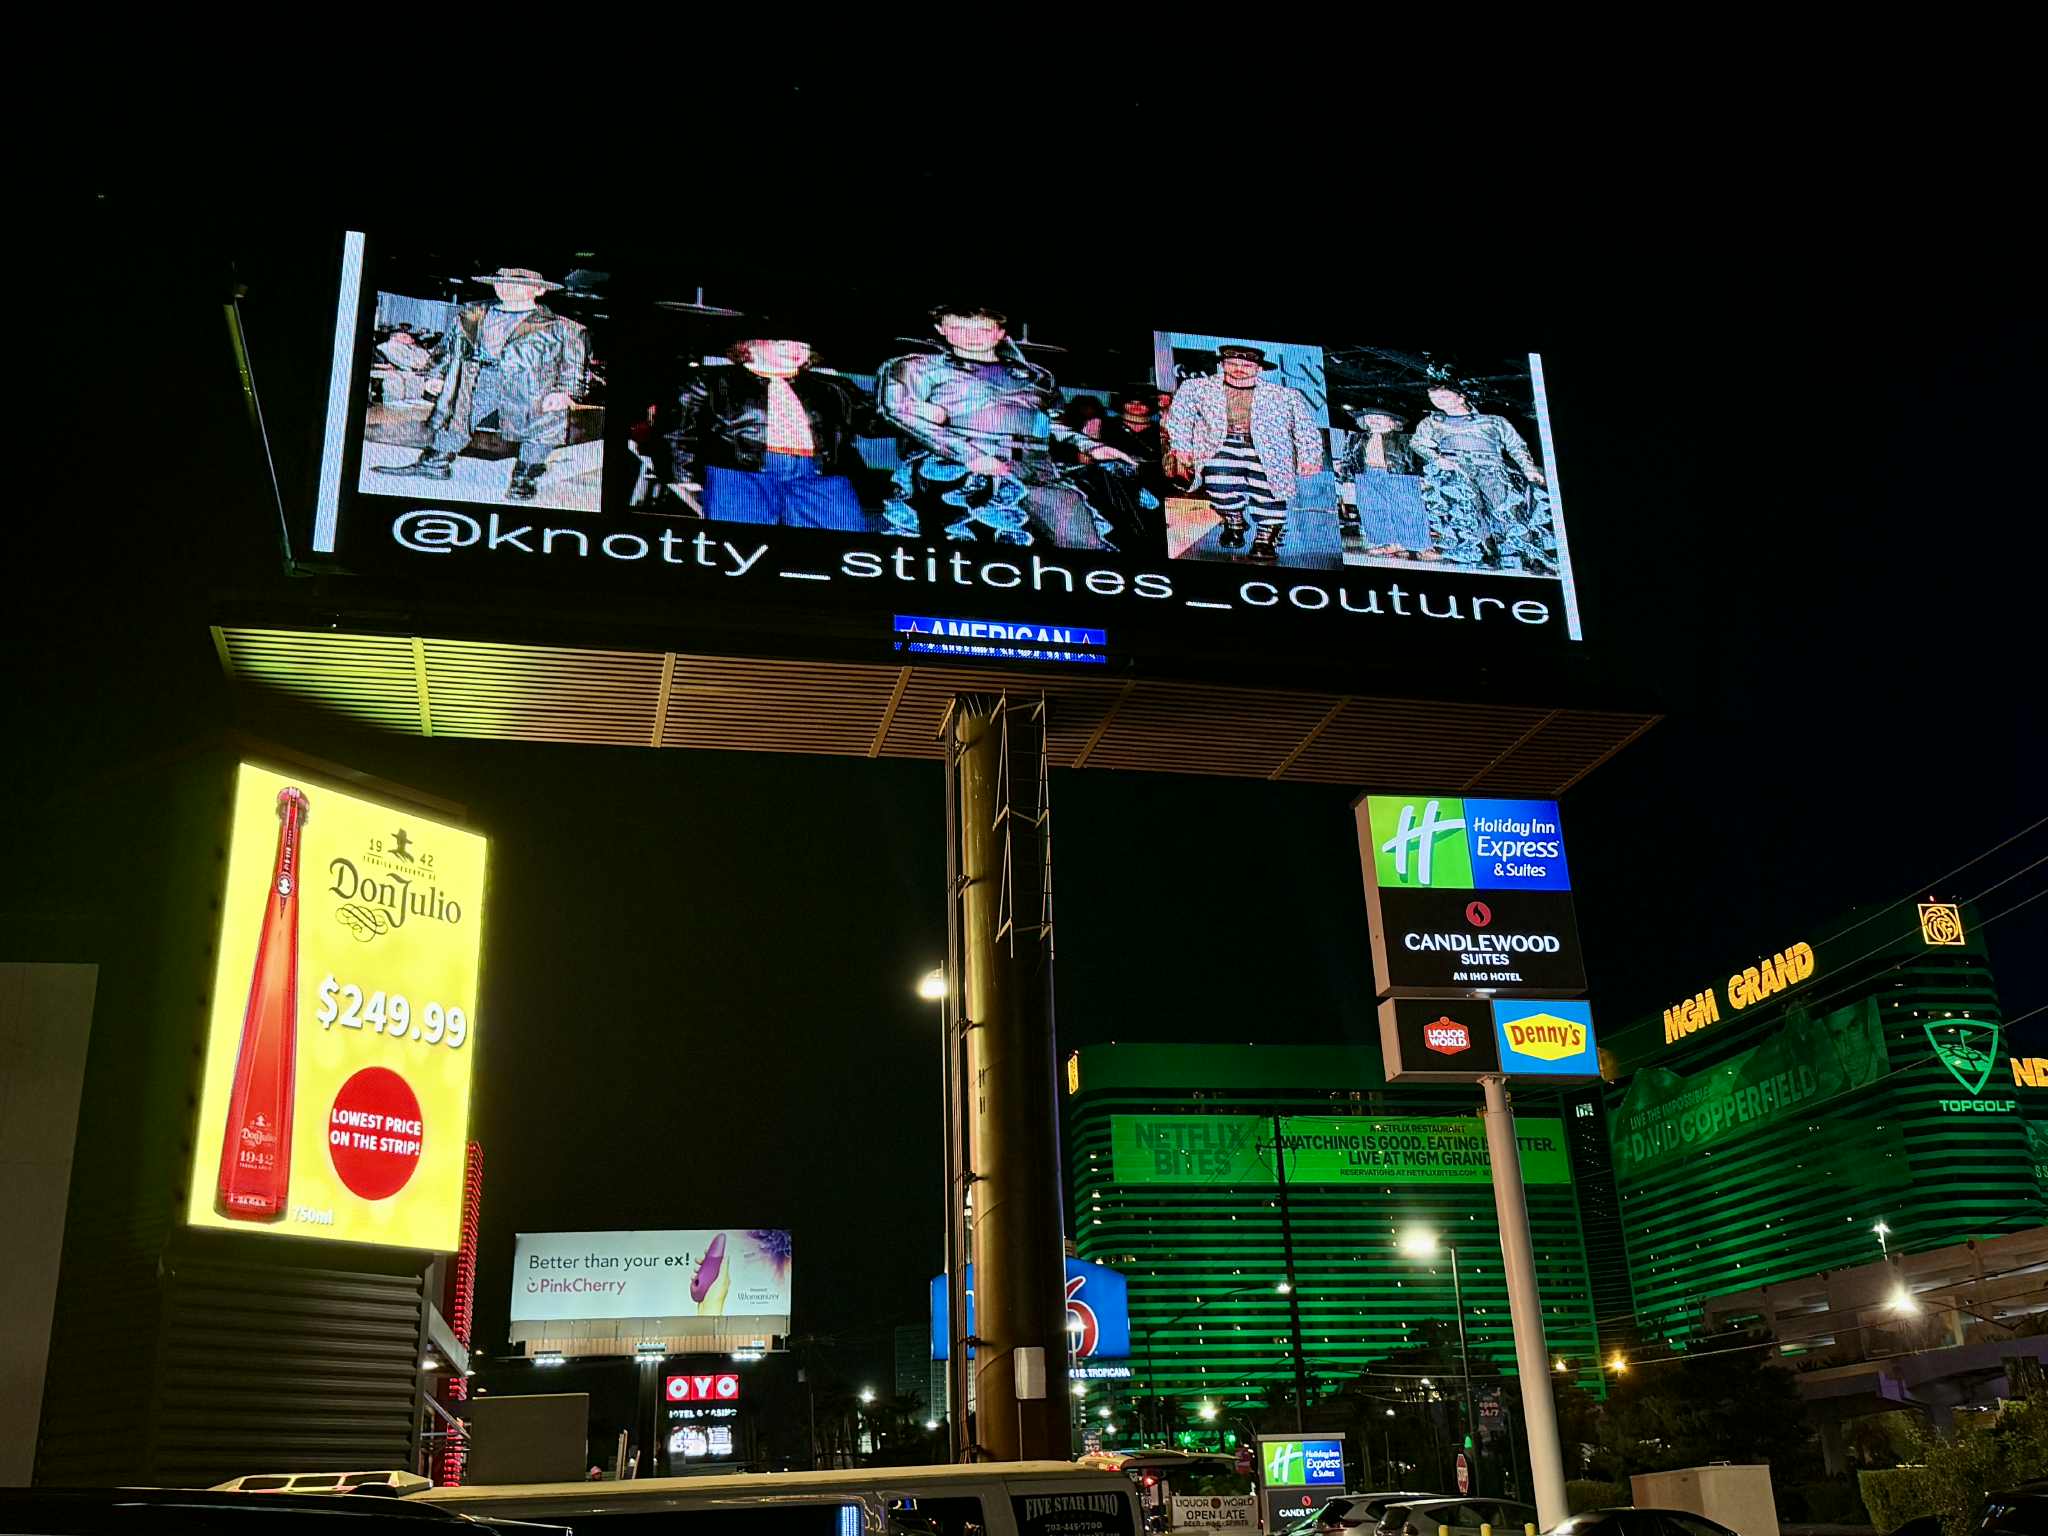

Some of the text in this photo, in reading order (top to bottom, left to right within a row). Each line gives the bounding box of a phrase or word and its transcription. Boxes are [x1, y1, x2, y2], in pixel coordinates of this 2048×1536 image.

[392, 509, 1550, 625] @knotty_stitches_couture
[1473, 817, 1555, 836] Holiday Inn
[1477, 836, 1559, 861] Express
[1494, 864, 1546, 877] & Suites
[1404, 933, 1560, 952] CANDLEWOOD
[1461, 954, 1510, 965] SUITES
[1453, 972, 1522, 982] AN IHG HOTEL
[1664, 942, 1814, 1045] MGM GRAND
[317, 973, 467, 1048] $249.99
[1427, 1029, 1466, 1039] LIQUOR
[1429, 1037, 1467, 1047] WORLD
[1510, 1023, 1580, 1047] Denny's
[1939, 1100, 2016, 1112] TOPGOLF
[332, 1108, 422, 1136] LOWEST PRICE
[330, 1130, 420, 1156] ON THE STRIP!
[1135, 1122, 1249, 1176] NETFLIX BITES
[1283, 1135, 1359, 1150] WATCHING
[1362, 1136, 1376, 1150] IS
[1378, 1136, 1425, 1150] GOOD.
[1428, 1136, 1478, 1151] EATING
[1349, 1151, 1381, 1165] LIVE
[1383, 1151, 1401, 1165] AT
[1402, 1152, 1441, 1165] MGM
[529, 1252, 690, 1271] Better than your ex!
[540, 1277, 627, 1295] PinkCherry
[1087, 1368, 1130, 1377] TROPICANA
[668, 1376, 737, 1400] OYO
[1306, 1459, 1340, 1470] Express
[1025, 1494, 1119, 1521] FIVE STAR LIMO
[1176, 1498, 1254, 1507] LIQUOR WORLD
[1186, 1509, 1245, 1520] OPEN LATE
